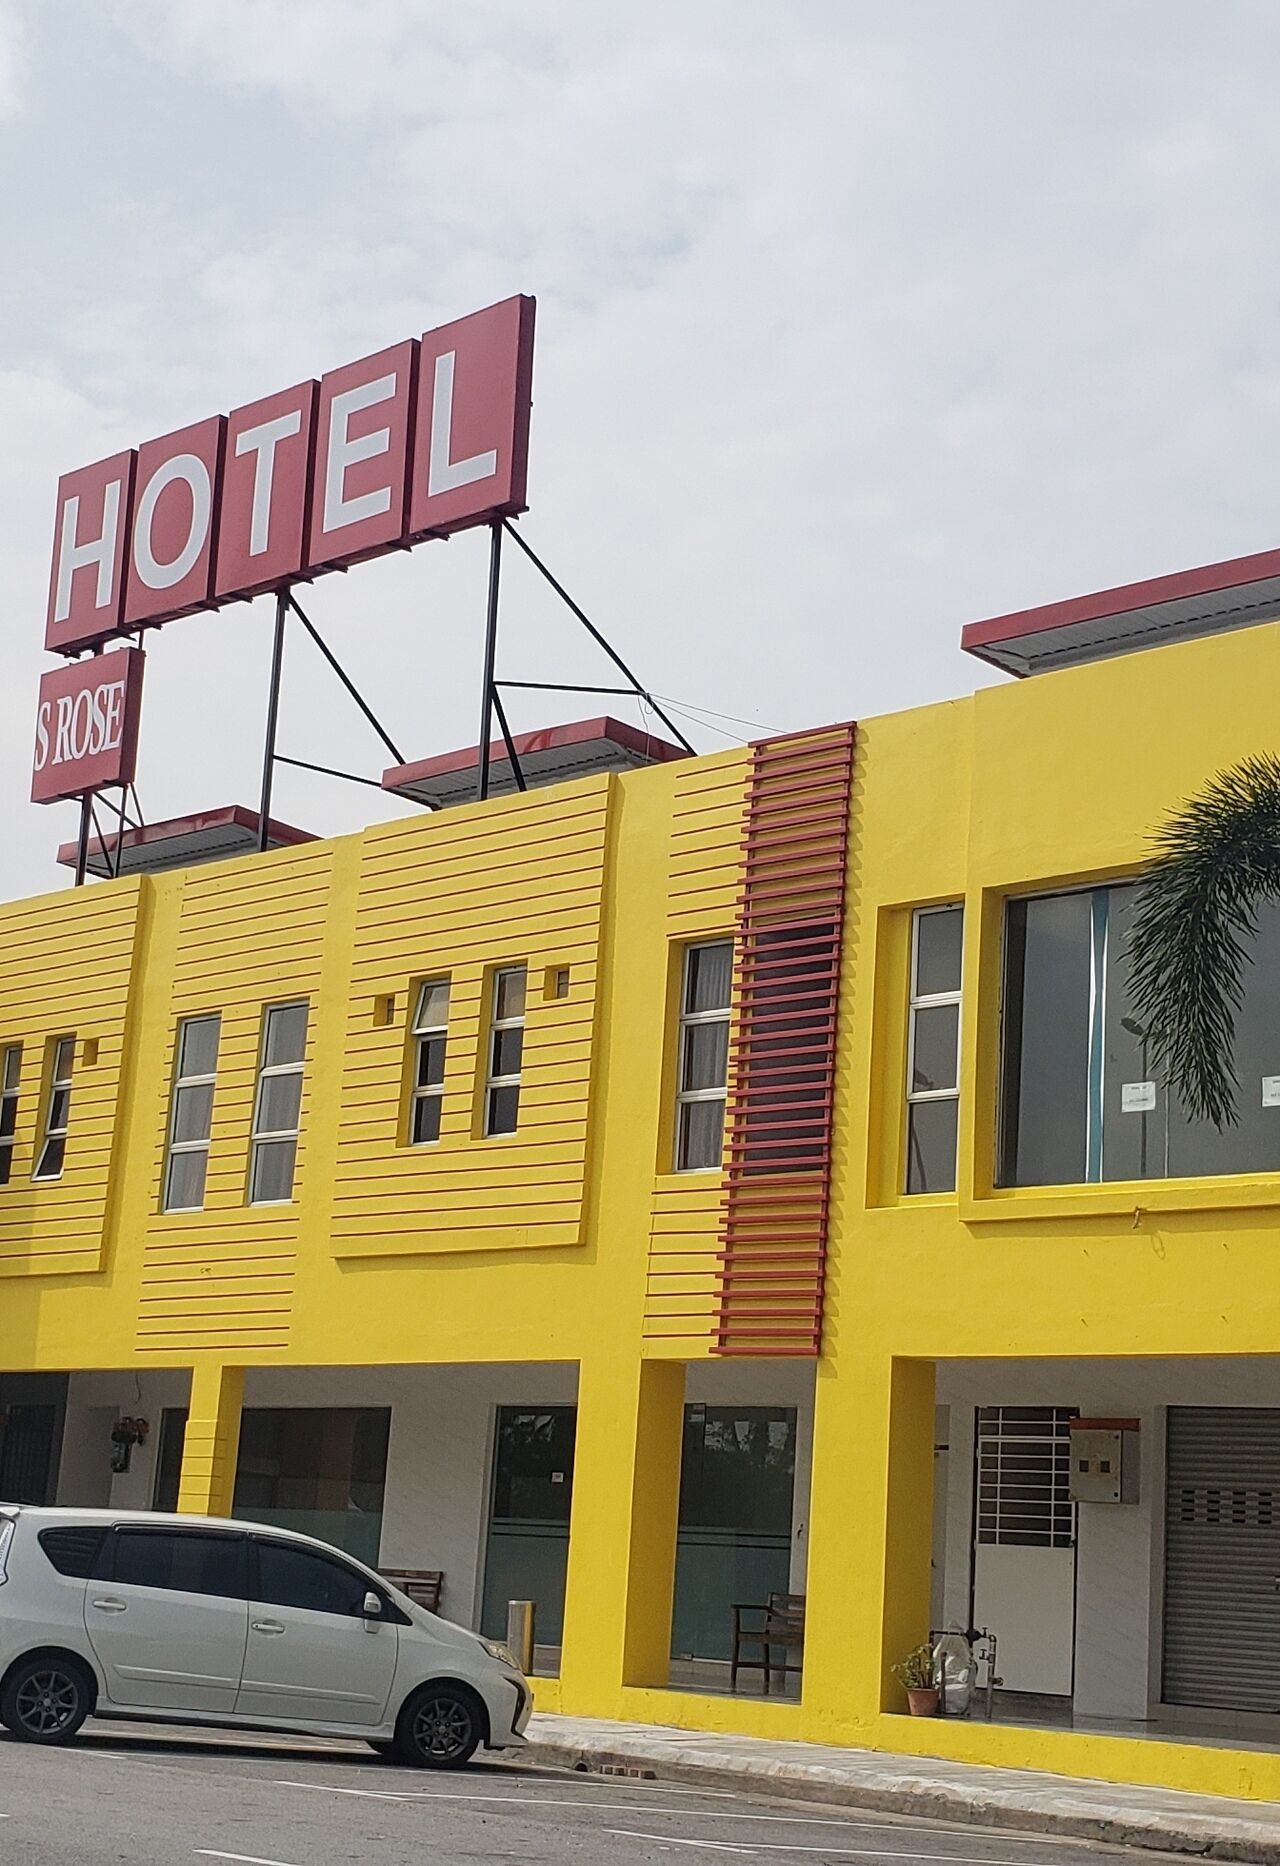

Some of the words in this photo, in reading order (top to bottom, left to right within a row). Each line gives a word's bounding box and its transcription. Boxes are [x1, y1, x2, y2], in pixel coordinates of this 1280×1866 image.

[54, 350, 497, 623] HOTEL
[34, 701, 51, 771] S
[51, 680, 125, 765] ROSE
